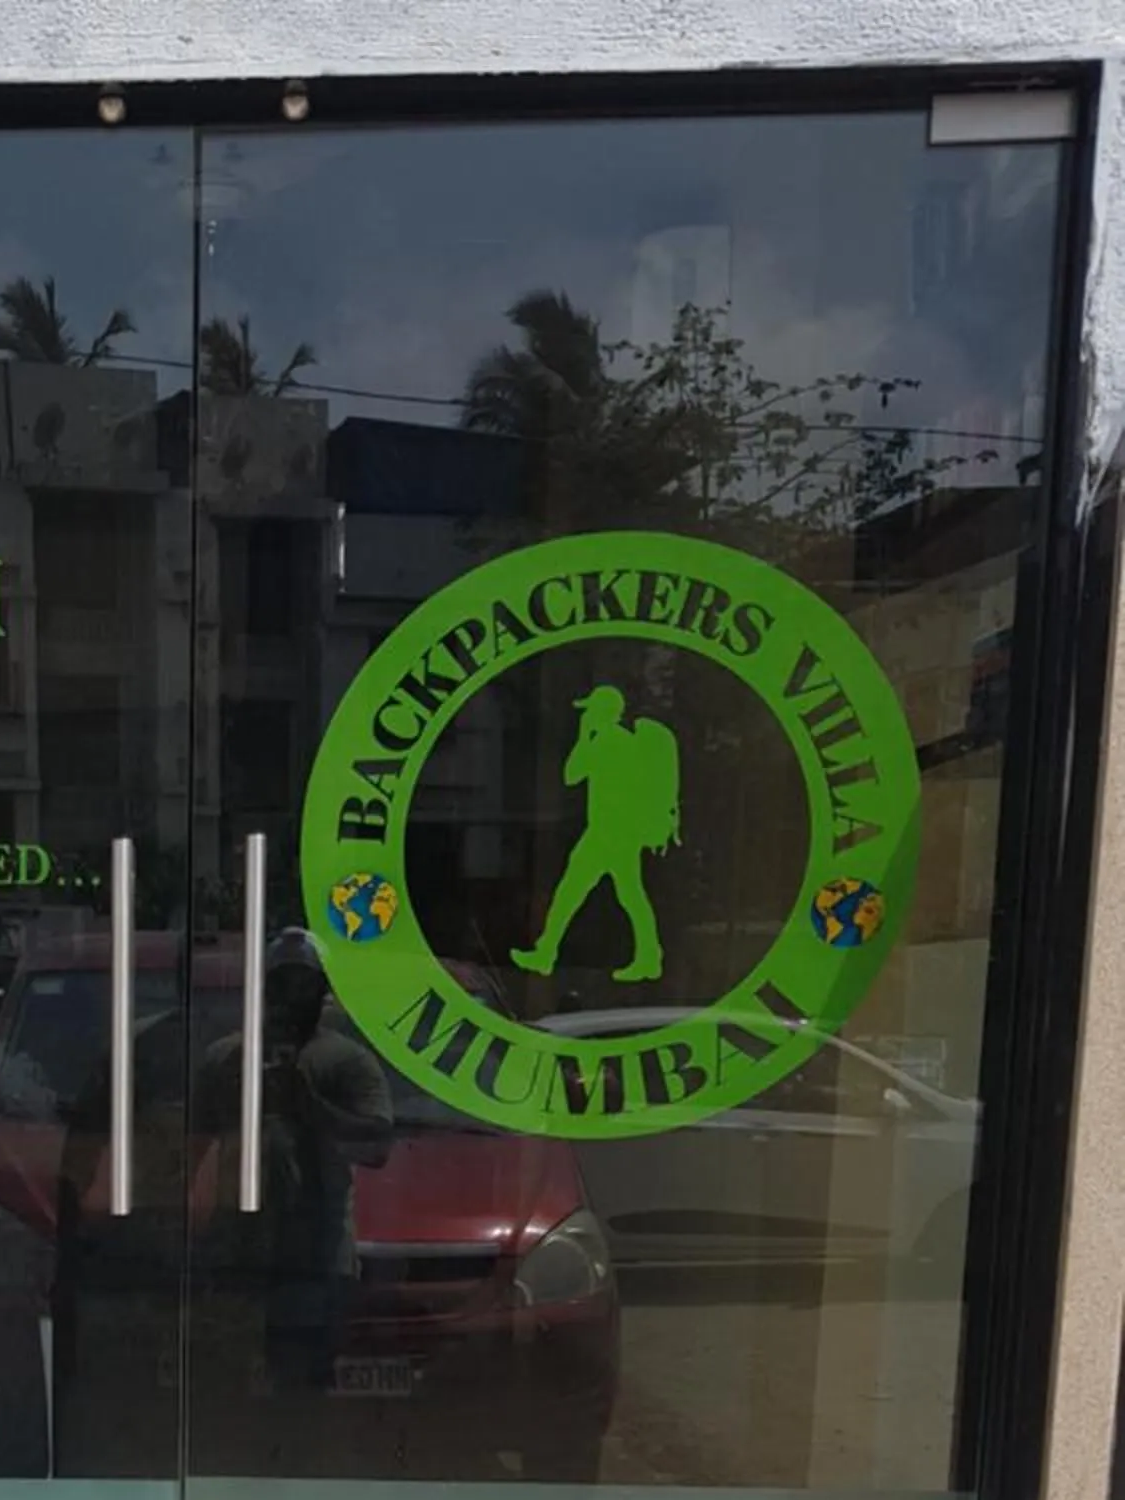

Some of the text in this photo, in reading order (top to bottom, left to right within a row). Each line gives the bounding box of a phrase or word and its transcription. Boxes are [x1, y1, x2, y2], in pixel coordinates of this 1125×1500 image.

[336, 567, 884, 856] BACKPACKERS VILLA
[386, 980, 817, 1116] MUMBAI
